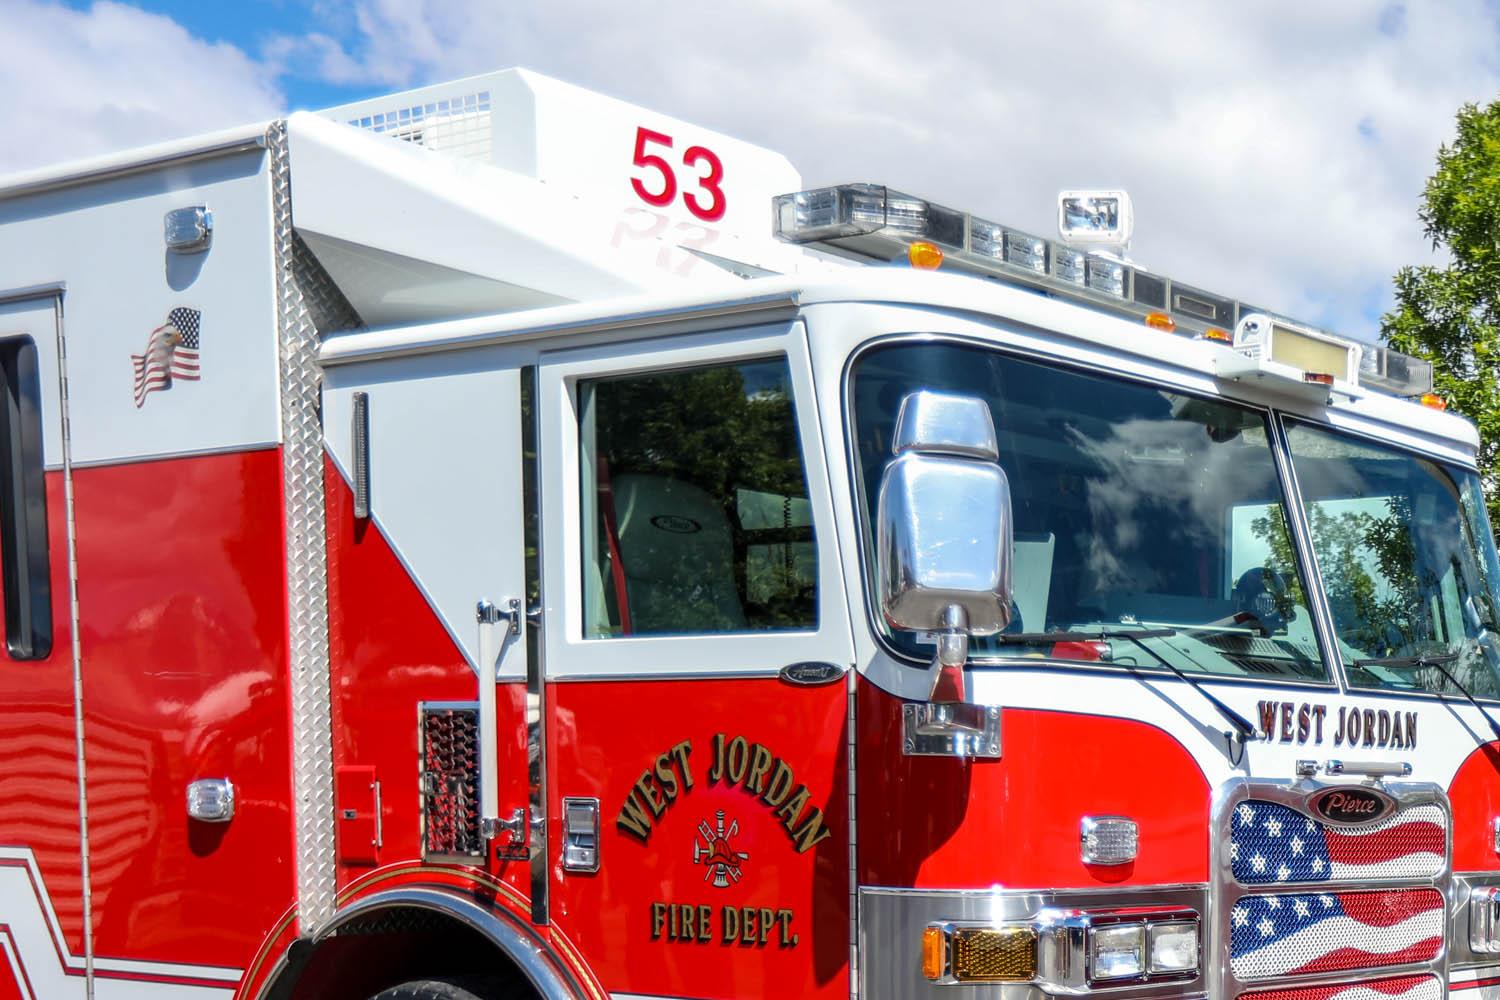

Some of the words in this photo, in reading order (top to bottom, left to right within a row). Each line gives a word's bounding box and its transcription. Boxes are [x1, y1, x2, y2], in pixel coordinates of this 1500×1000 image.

[631, 126, 727, 223] 53
[1257, 700, 1327, 744] WEST
[1335, 707, 1418, 749] JORDAN
[616, 740, 693, 841] WEST
[709, 733, 832, 855] JORDAN
[1325, 792, 1377, 816] Pierce
[652, 902, 712, 940] FIRE
[722, 906, 799, 946] DEPT.
